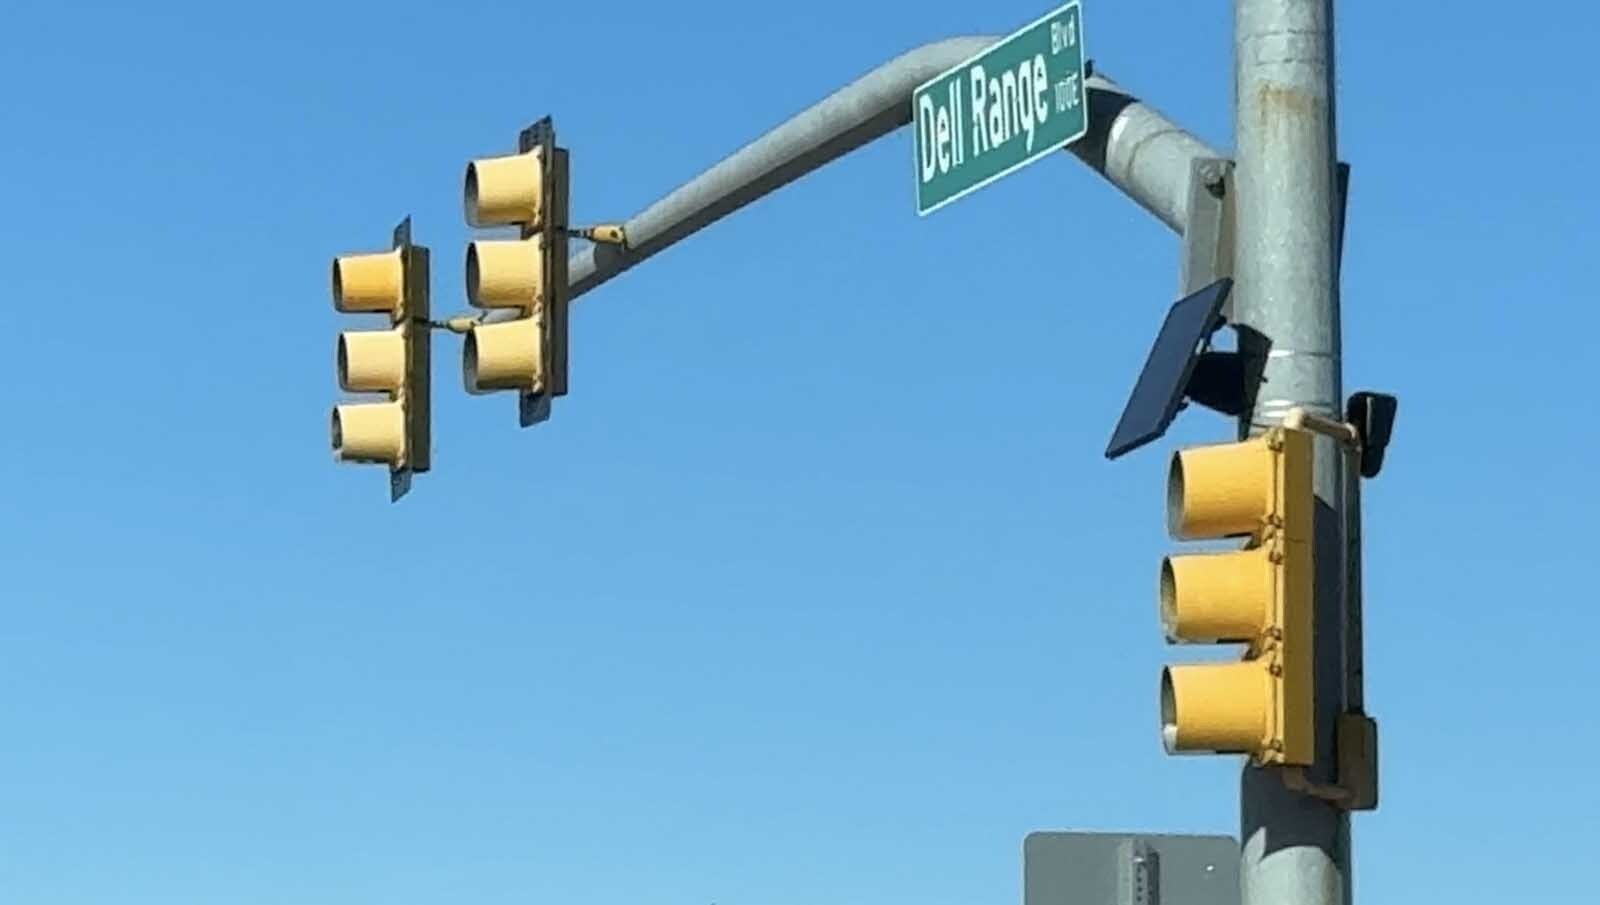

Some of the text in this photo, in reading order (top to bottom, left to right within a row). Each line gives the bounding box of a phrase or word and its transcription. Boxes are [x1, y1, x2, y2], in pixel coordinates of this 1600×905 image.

[919, 14, 1075, 183] Dell Range Blvd
